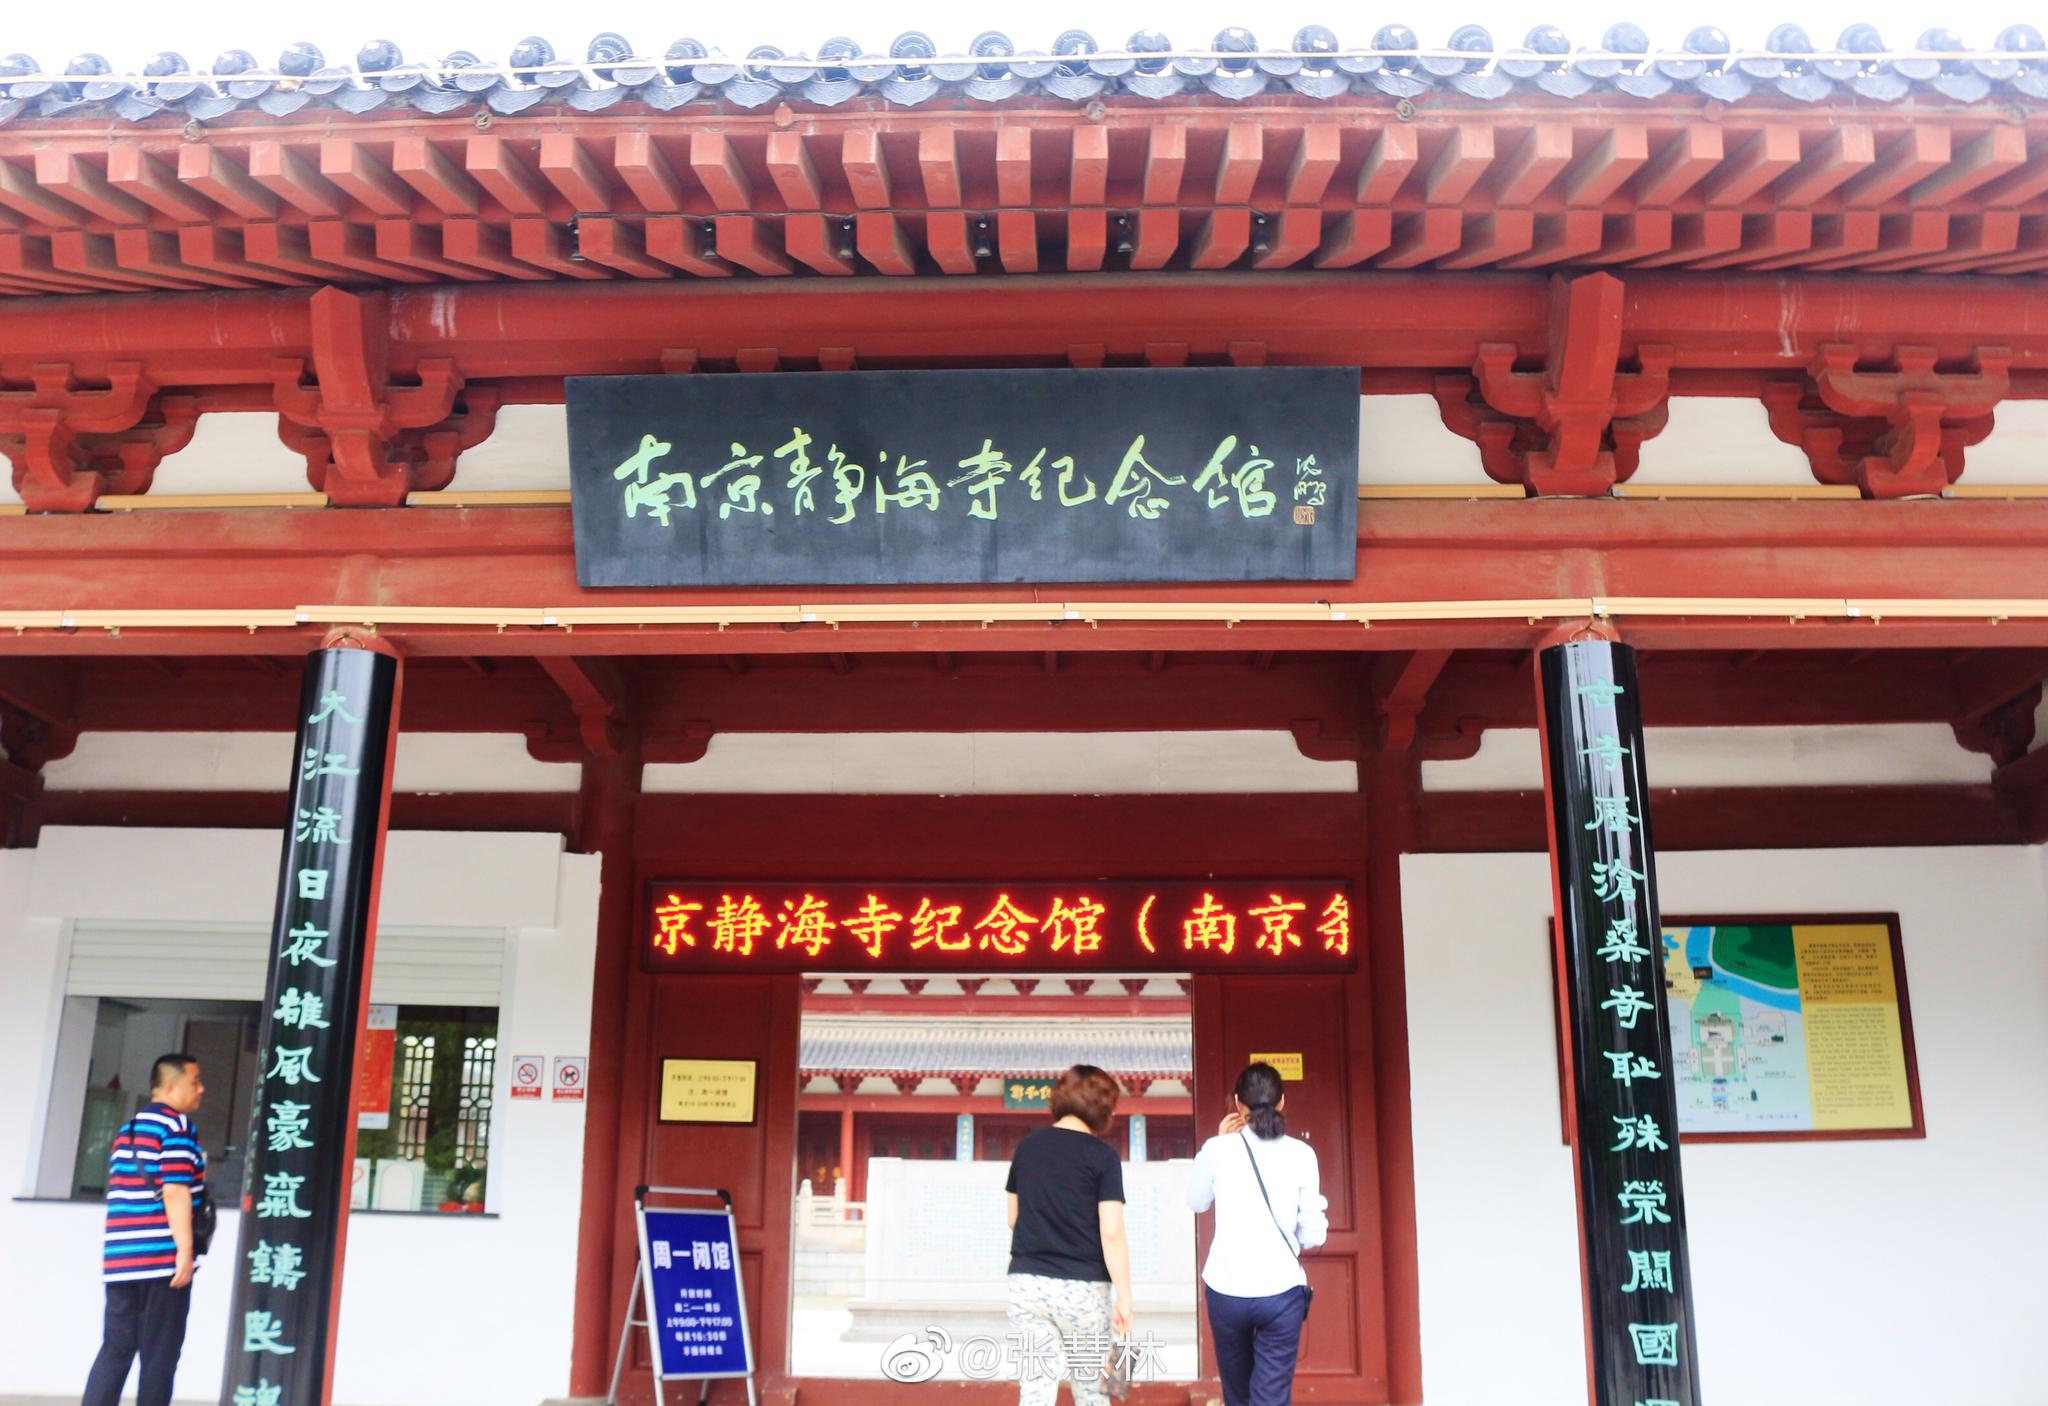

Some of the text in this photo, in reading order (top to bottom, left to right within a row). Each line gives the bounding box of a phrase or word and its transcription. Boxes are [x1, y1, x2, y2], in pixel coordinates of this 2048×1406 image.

[613, 426, 1276, 526] 南京静海寺纪念馆
[652, 1240, 731, 1270] 周一闭馆
